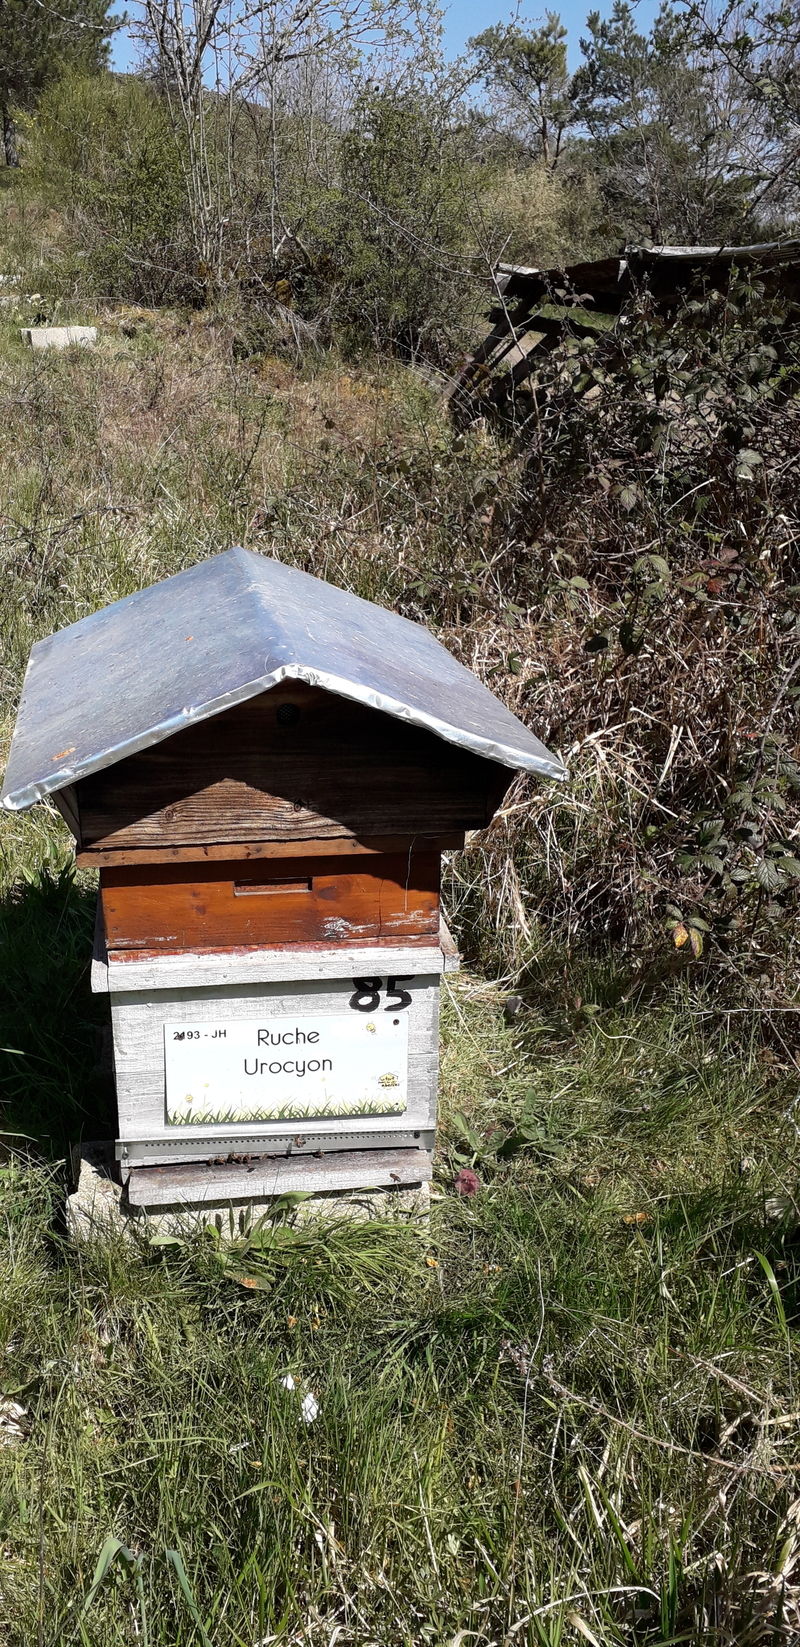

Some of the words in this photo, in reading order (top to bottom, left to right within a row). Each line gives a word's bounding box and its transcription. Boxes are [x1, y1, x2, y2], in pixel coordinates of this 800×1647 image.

[349, 975, 415, 1012] 85
[211, 1029, 227, 1039] JH
[257, 1027, 320, 1047] Ruche
[244, 1058, 333, 1077] Urocyon
